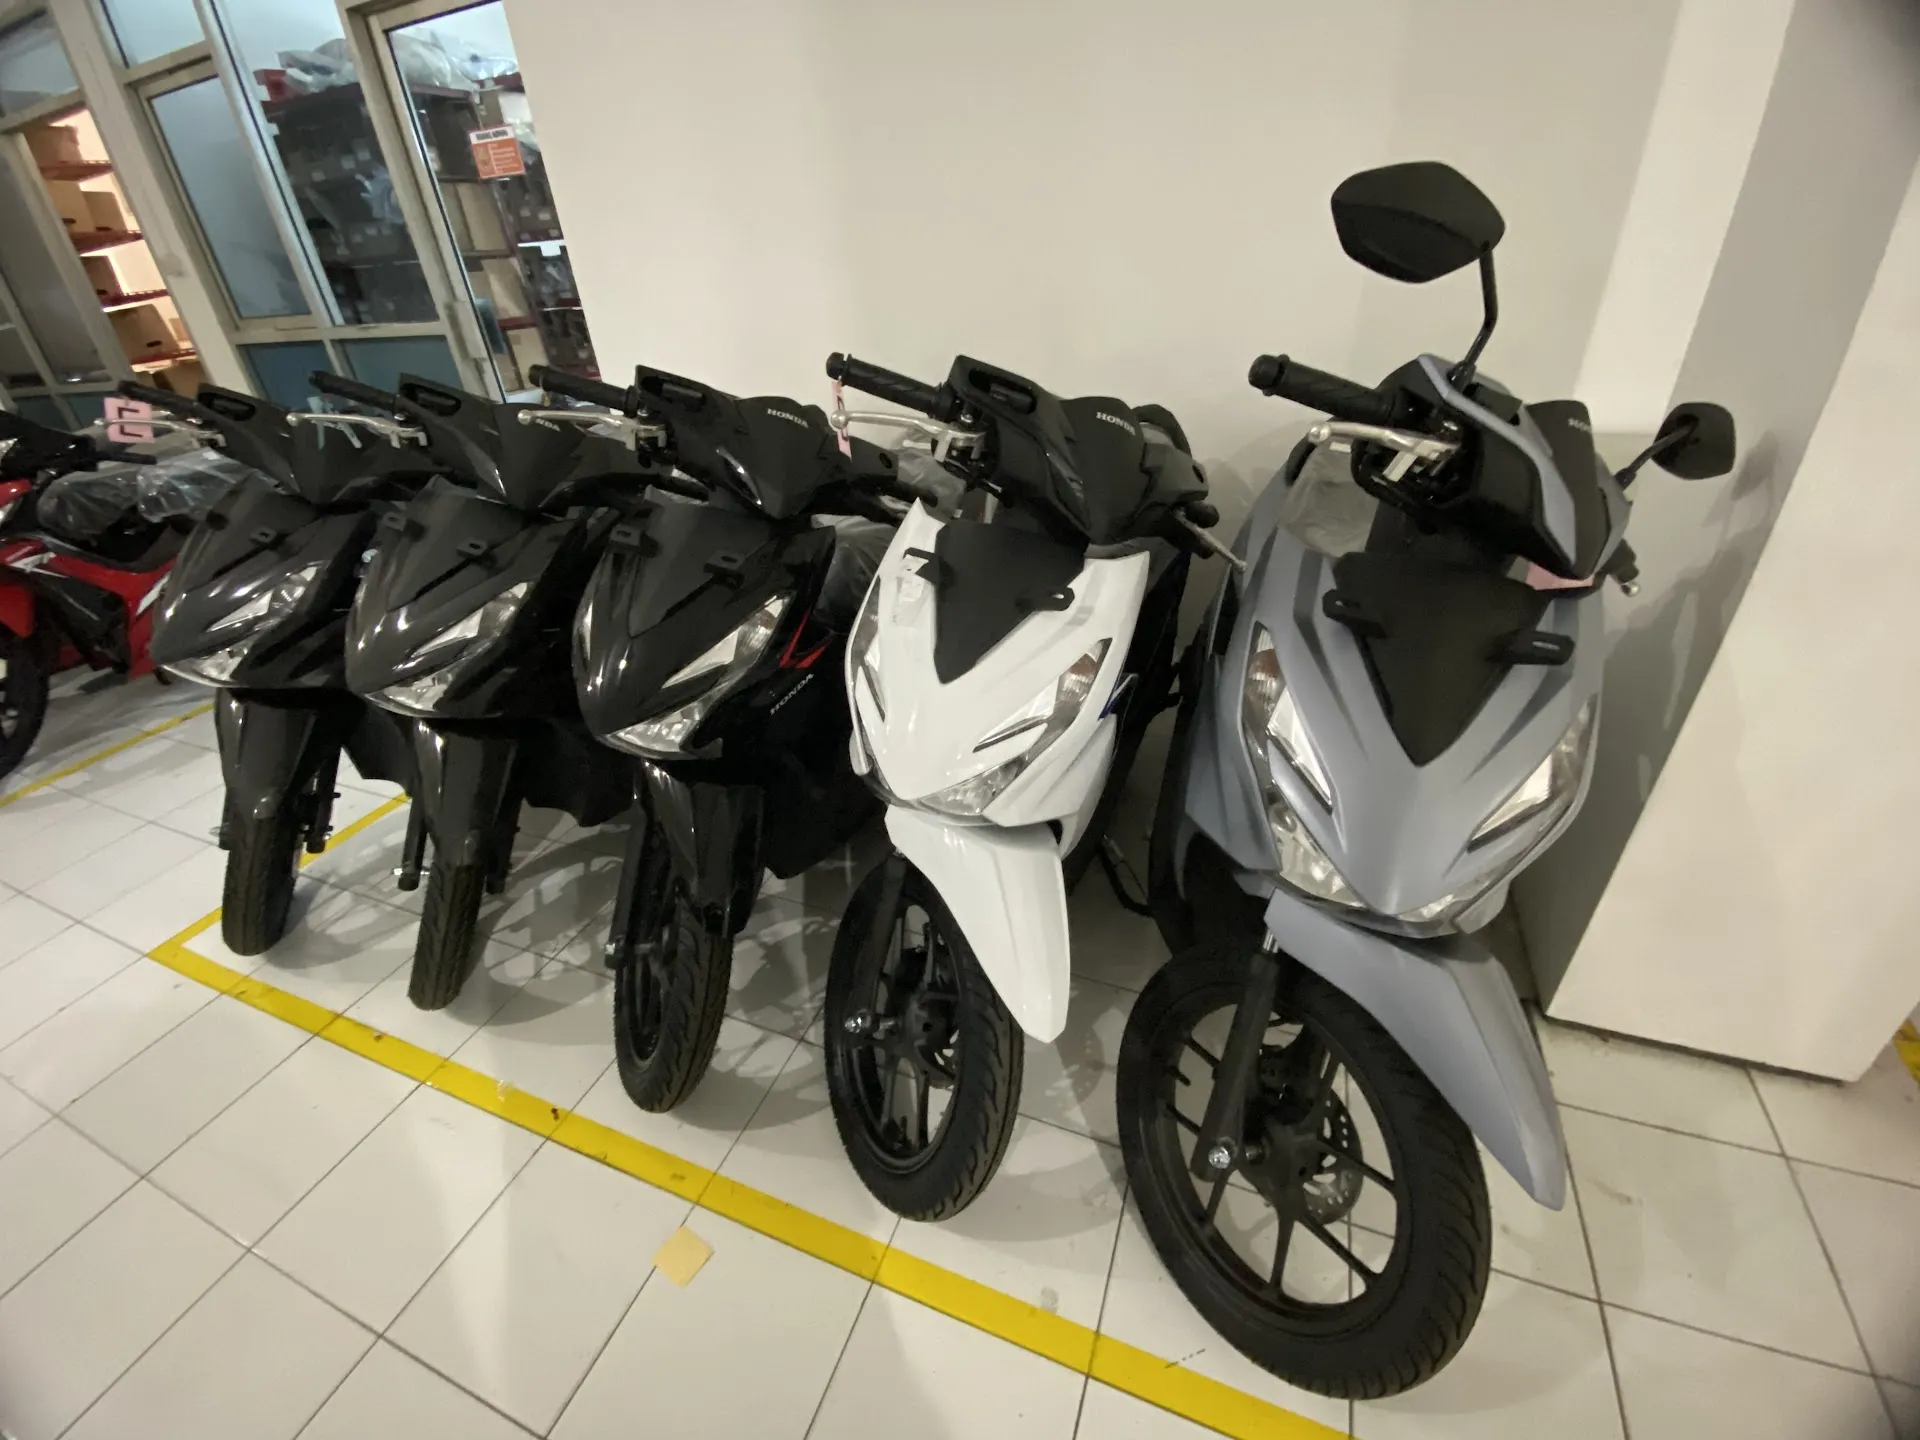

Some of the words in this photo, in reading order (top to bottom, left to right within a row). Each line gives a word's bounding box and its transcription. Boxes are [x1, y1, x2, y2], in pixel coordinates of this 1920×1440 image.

[766, 407, 809, 429] HONDA
[1096, 411, 1136, 436] HONDA
[769, 673, 815, 715] HONDA
